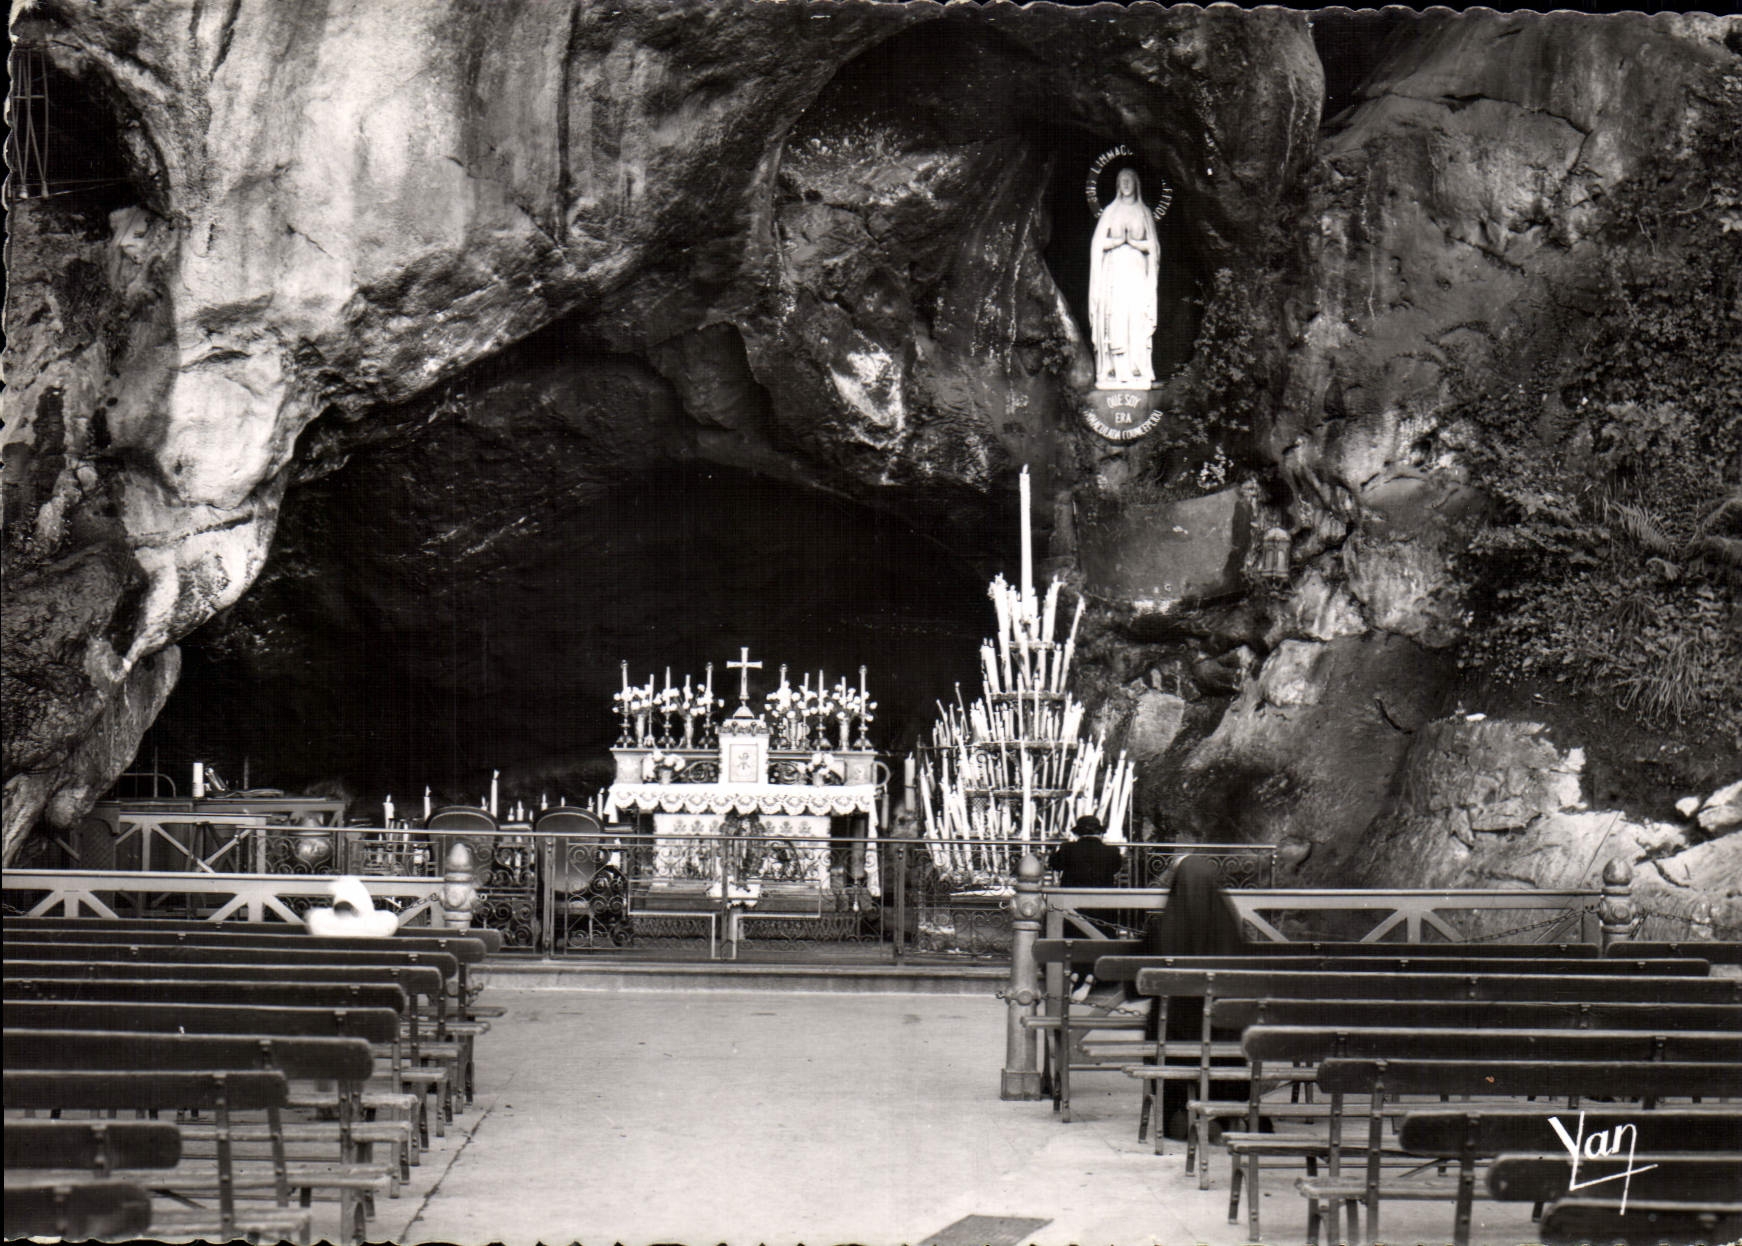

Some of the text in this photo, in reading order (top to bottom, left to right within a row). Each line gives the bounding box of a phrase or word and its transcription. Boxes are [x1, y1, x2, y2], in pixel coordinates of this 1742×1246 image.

[1106, 393, 1142, 409] QUE SOY
[1114, 412, 1133, 424] ERA
